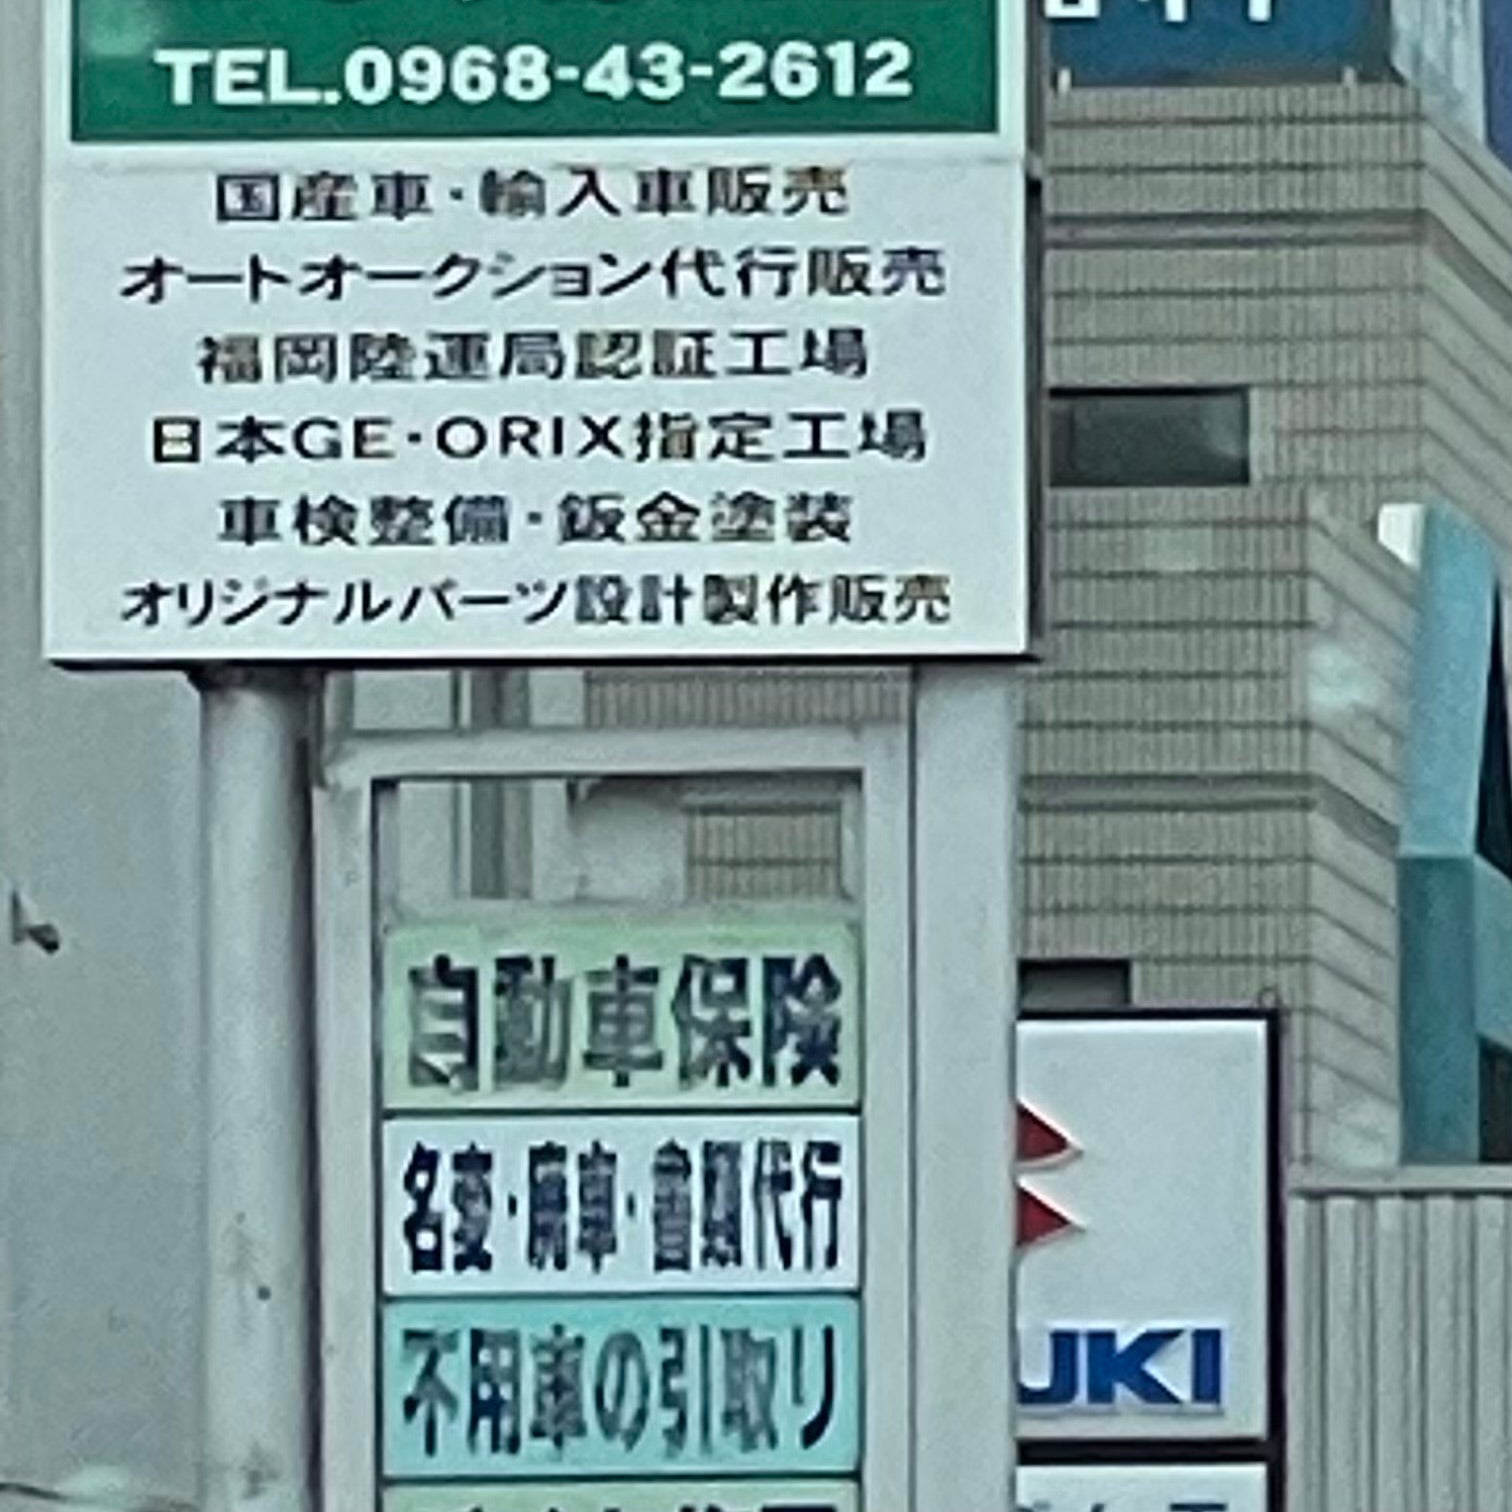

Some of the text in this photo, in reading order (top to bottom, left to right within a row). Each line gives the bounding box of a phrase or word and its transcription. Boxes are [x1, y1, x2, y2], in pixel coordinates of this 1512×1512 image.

[153, 39, 913, 106] TEL.0968-43-2612
[119, 245, 946, 306] オートオークション代行販売
[196, 327, 869, 385] 福岡陸運局認証工場
[407, 952, 842, 1091] 自動車保険
[402, 1324, 836, 1457] 不用車の引取り
